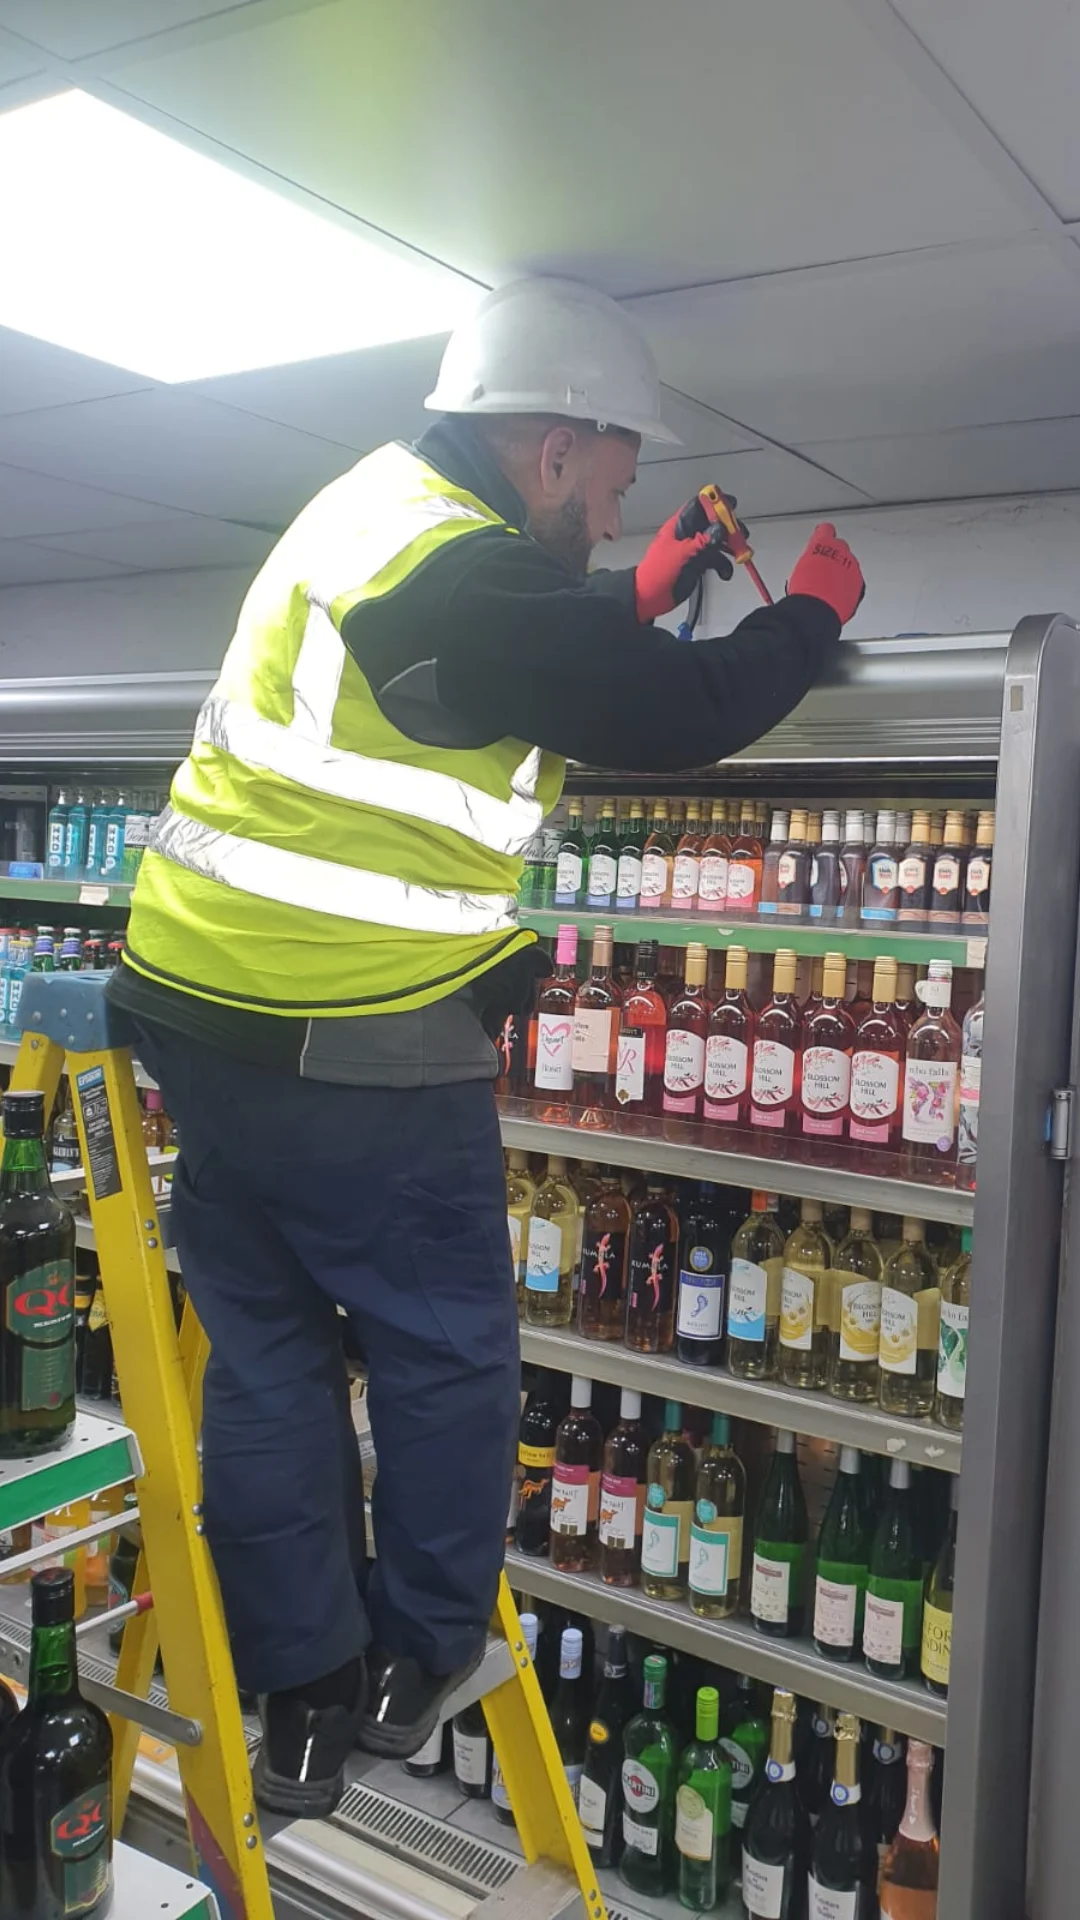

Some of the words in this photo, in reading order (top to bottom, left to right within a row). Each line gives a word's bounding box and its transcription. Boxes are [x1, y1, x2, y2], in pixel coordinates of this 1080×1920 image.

[812, 544, 838, 560] SIZE
[807, 1072, 840, 1082] BLOSSOM
[814, 1081, 830, 1089] HILL
[861, 1088, 875, 1096] HILL
